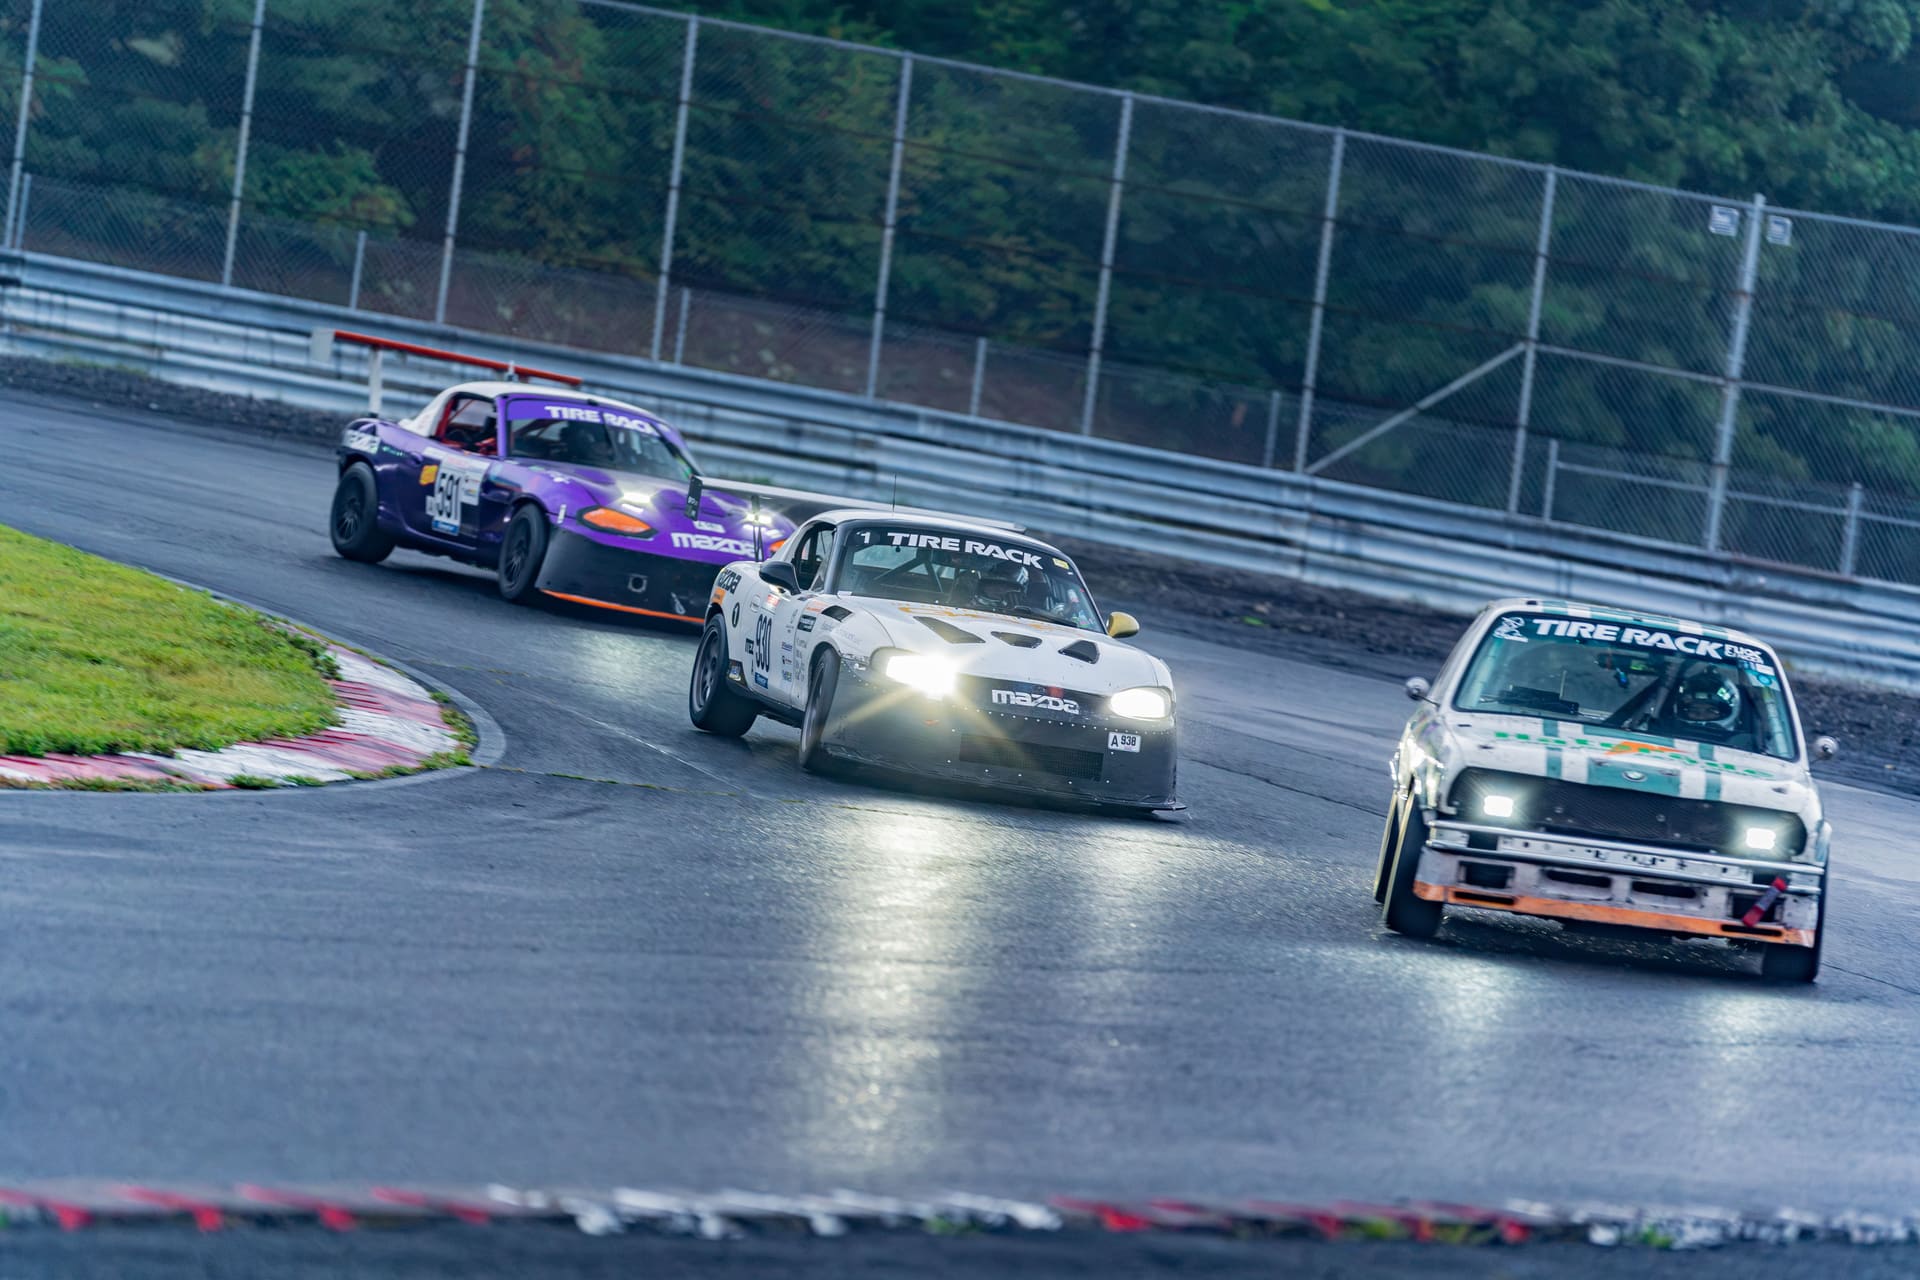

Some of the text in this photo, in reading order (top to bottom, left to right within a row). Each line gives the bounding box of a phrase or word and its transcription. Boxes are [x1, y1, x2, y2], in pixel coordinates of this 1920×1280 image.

[544, 405, 601, 423] TIRE
[438, 472, 461, 520] 591
[887, 532, 1044, 570] TIRE RACK
[755, 613, 772, 673] 930
[1532, 618, 1620, 641] TIRE
[1620, 627, 1723, 660] RACK
[991, 689, 1080, 715] mazda
[1111, 735, 1119, 747] A
[1121, 735, 1137, 746] 938
